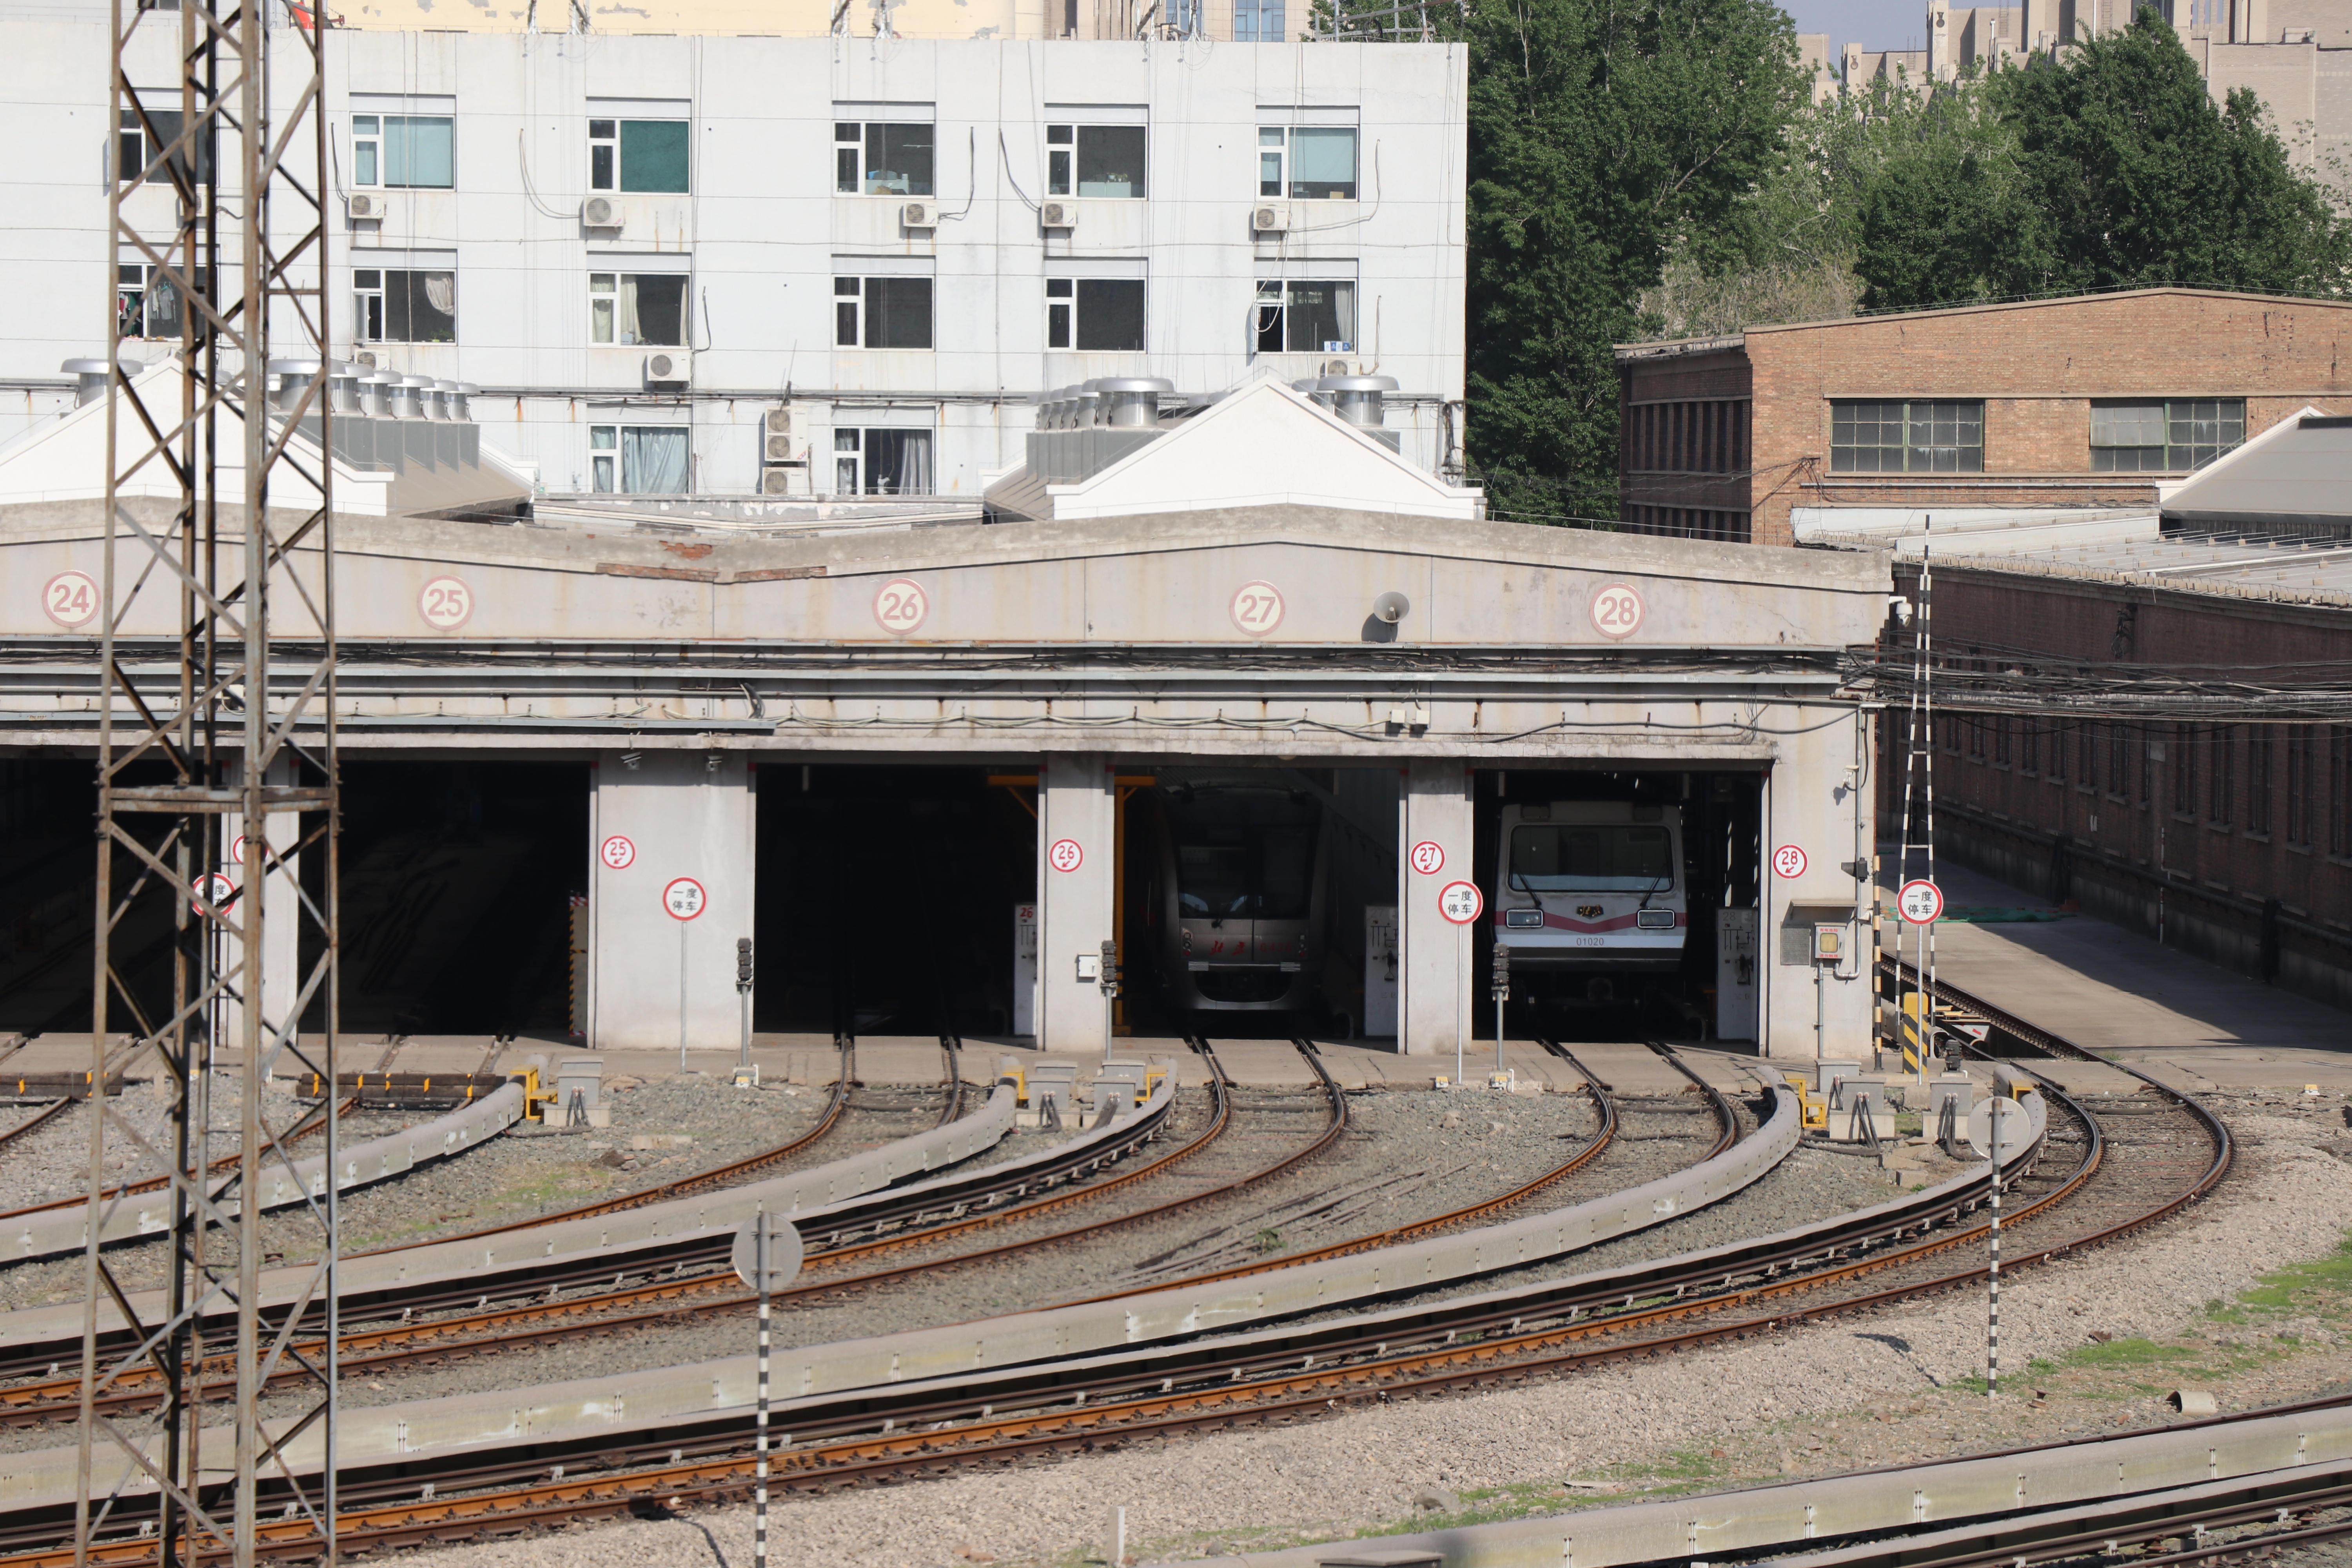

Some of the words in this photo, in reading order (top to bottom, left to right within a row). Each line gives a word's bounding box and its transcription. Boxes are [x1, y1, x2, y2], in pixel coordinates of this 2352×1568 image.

[53, 585, 89, 613] 24
[428, 589, 463, 616] 25
[883, 592, 918, 620] 26
[1240, 595, 1276, 623] 27
[1600, 597, 1635, 625] 28
[610, 842, 626, 856] 25
[1058, 846, 1074, 859] 26
[1420, 848, 1435, 862] 27
[1782, 851, 1798, 865] 28
[673, 888, 697, 898] 一度
[1448, 890, 1472, 901] 一度
[1908, 891, 1932, 902] 一度
[673, 900, 696, 911] 停车
[1448, 903, 1472, 915] 停车
[1908, 904, 1932, 915] 停车
[1020, 907, 1033, 918] 26
[1723, 912, 1735, 921] 28
[1576, 938, 1604, 946] 01020
